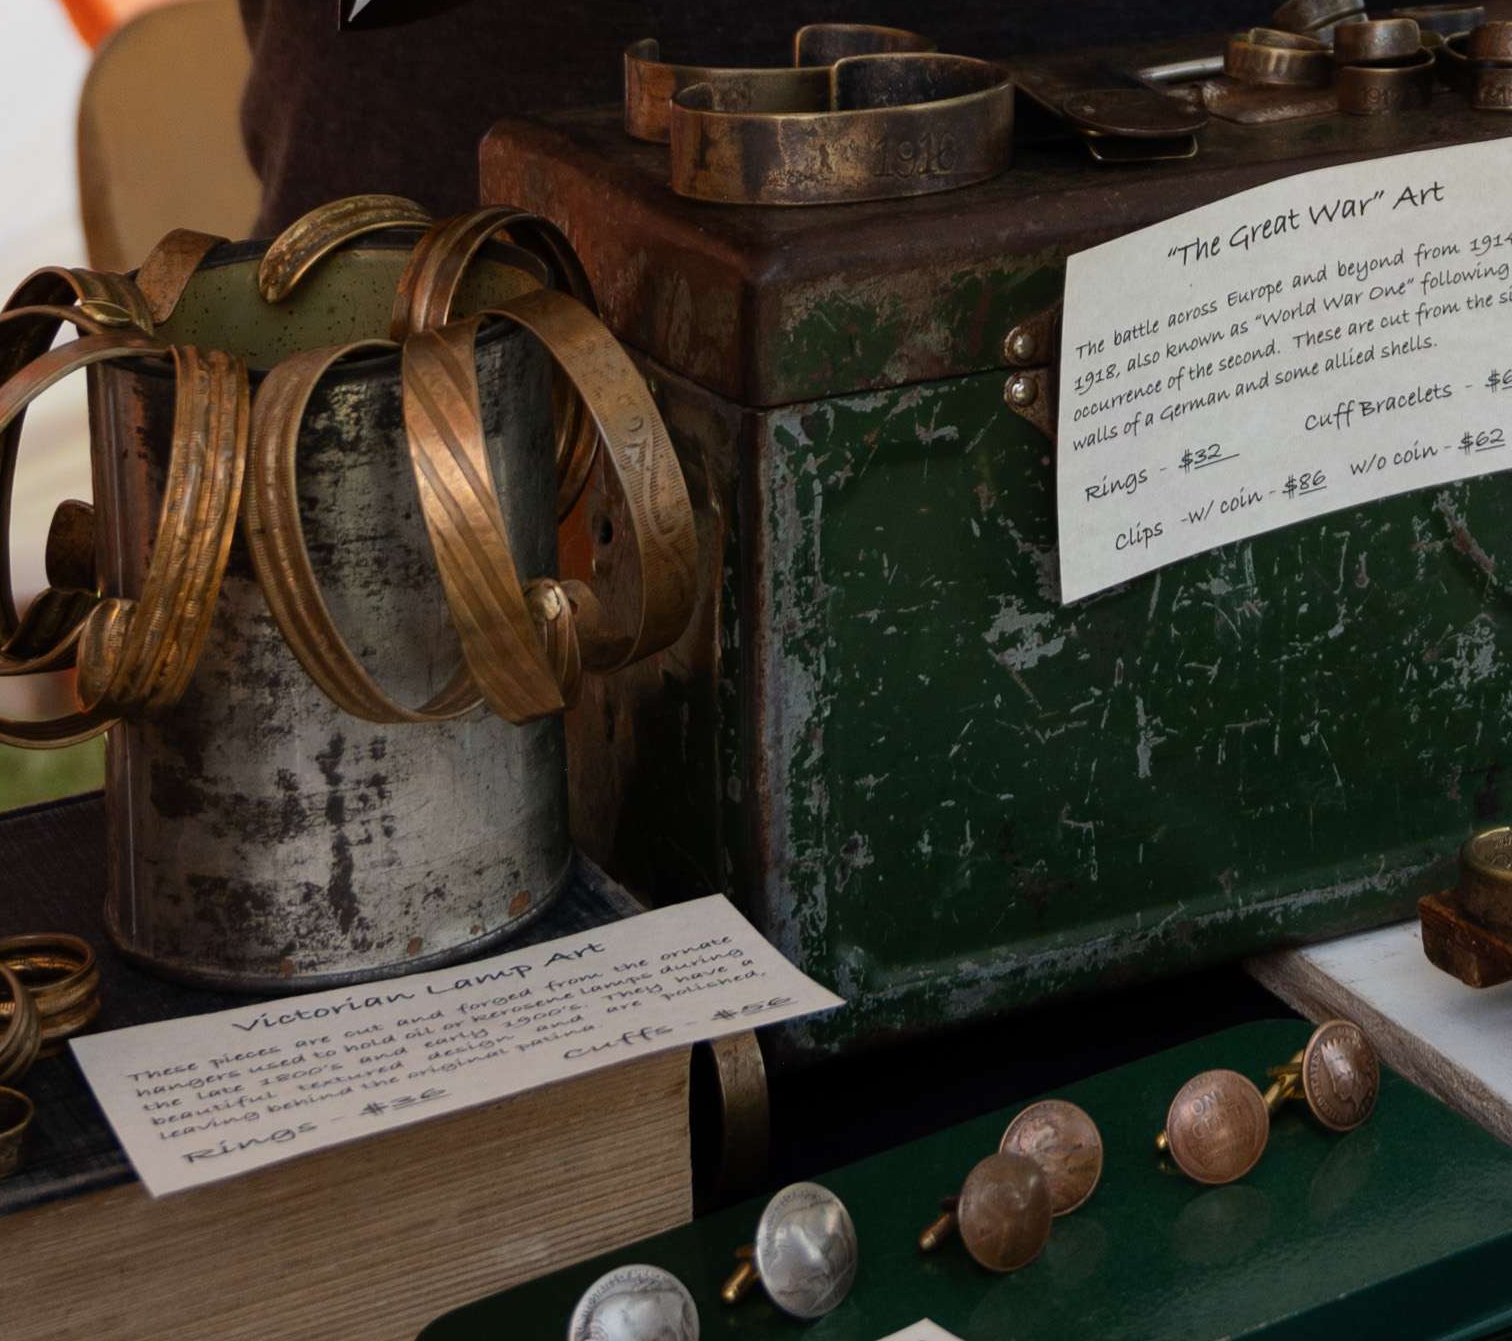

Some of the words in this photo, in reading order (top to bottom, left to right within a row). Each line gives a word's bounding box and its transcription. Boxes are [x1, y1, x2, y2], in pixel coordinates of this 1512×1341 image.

[1168, 234, 1220, 266] "The
[1229, 209, 1300, 251] Great
[1310, 190, 1384, 225] War"
[1393, 181, 1445, 209] Art
[1073, 364, 1121, 396] 1918,
[1127, 351, 1160, 372] also
[1167, 330, 1224, 357] known
[1230, 321, 1249, 337] as
[1256, 298, 1316, 327] "World
[1324, 292, 1364, 312] War
[1369, 278, 1414, 300] One"
[1420, 260, 1510, 295] following
[1076, 338, 1105, 360] The
[1114, 319, 1159, 347] battle
[1168, 300, 1217, 328] across
[1228, 279, 1283, 308] Europe
[1293, 266, 1327, 288] and
[1338, 249, 1404, 281] beyond
[1414, 243, 1460, 267] from
[1073, 379, 1162, 422] occurrence
[1168, 369, 1185, 392] of
[1189, 362, 1212, 383] the
[1219, 339, 1281, 370] second.
[1293, 324, 1341, 349] These
[1348, 319, 1374, 336] are
[1381, 311, 1409, 329] cut
[1415, 303, 1460, 326] from
[1467, 292, 1493, 310] the
[1073, 425, 1118, 451] walls
[1124, 416, 1141, 437] of
[1145, 412, 1154, 426] a
[1161, 389, 1230, 421] German
[1235, 372, 1270, 397] and
[1275, 360, 1319, 384] some
[1326, 345, 1374, 370] allied
[1381, 335, 1437, 359] shells.
[1305, 401, 1355, 431] Cuff
[1361, 382, 1453, 418] Bracelets
[1086, 466, 1148, 502] Rings
[1178, 442, 1230, 473] $32
[1350, 454, 1386, 478] w/o
[1393, 443, 1438, 467] coin
[1459, 429, 1506, 455] $62
[1115, 521, 1164, 552] Clips
[1220, 487, 1263, 516] coin
[1282, 470, 1327, 499] $86
[127, 1061, 199, 1083] These
[210, 1045, 282, 1069] pieces
[295, 1033, 331, 1049] are
[345, 1024, 386, 1039] cut
[397, 1010, 445, 1027] and
[458, 987, 531, 1015] forged
[544, 972, 603, 992] from
[614, 958, 649, 973] the
[660, 935, 733, 961] ornate
[135, 1070, 240, 1098] hangers
[249, 1054, 306, 1075] used
[313, 1046, 336, 1059] to
[343, 1032, 395, 1055] hold
[406, 1026, 440, 1042] oil
[443, 1017, 466, 1031] or
[471, 992, 573, 1024] kerosene
[580, 971, 653, 996] lamps
[660, 946, 745, 976] during
[232, 992, 415, 1032] Victorian
[426, 964, 532, 994] Lamp
[544, 942, 606, 966] Art
[142, 1097, 182, 1113] the
[197, 1084, 245, 1101] late
[360, 1046, 408, 1065] and
[424, 1025, 489, 1049] early
[600, 983, 664, 1004] They
[675, 965, 729, 984] have
[742, 958, 755, 968] a
[150, 1091, 278, 1127] beautiful
[298, 1060, 404, 1092] textured
[427, 1034, 514, 1061] design
[536, 1014, 585, 1032] and
[606, 1000, 642, 1014] are
[563, 1024, 674, 1061] Cuffs
[160, 1110, 260, 1141] leaving
[267, 1087, 355, 1113] behind
[361, 1074, 401, 1091] the
[407, 1048, 507, 1080] original
[182, 1121, 319, 1165] Rings
